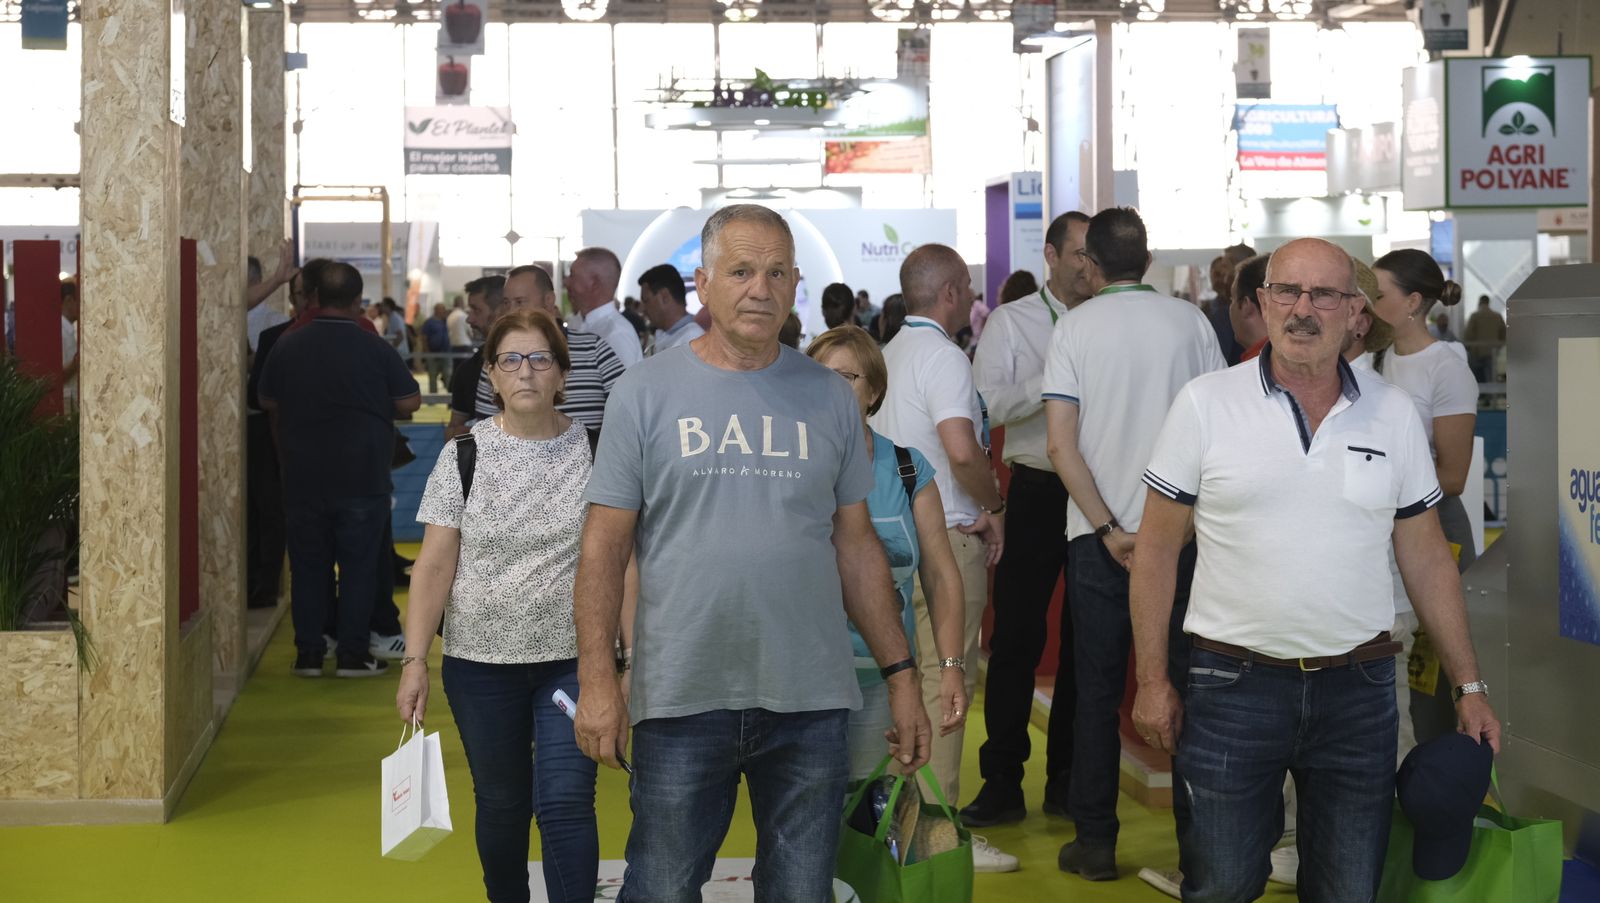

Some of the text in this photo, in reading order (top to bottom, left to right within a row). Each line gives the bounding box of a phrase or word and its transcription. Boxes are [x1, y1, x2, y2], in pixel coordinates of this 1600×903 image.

[1487, 144, 1545, 166] AGRI
[1461, 168, 1569, 190] POLYANE
[862, 241, 899, 256] Nutri
[677, 414, 809, 460] BALI
[692, 466, 735, 477] ALVARO
[754, 467, 801, 479] MORENO
